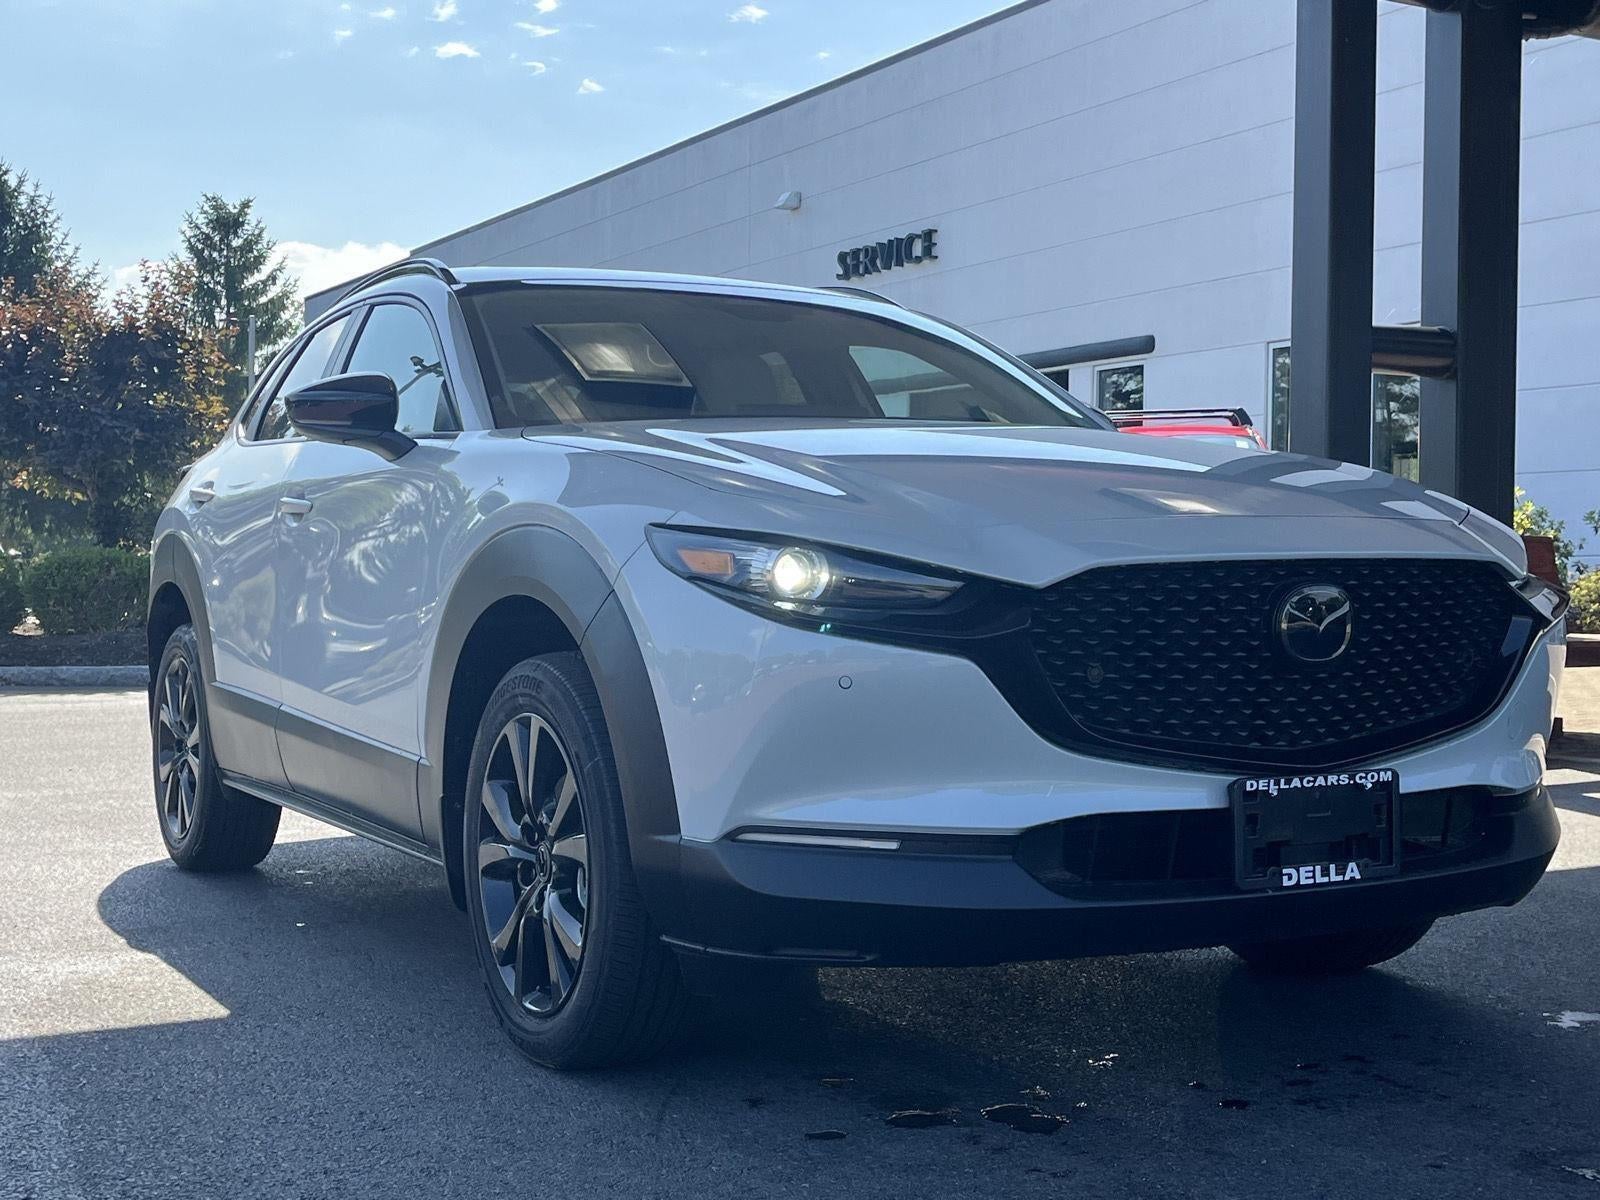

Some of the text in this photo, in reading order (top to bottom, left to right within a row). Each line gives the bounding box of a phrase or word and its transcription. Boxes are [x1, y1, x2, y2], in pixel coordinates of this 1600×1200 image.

[836, 228, 938, 280] SERVICE
[1245, 771, 1393, 792] DELLACARS.COM
[1282, 862, 1362, 887] DELLA
